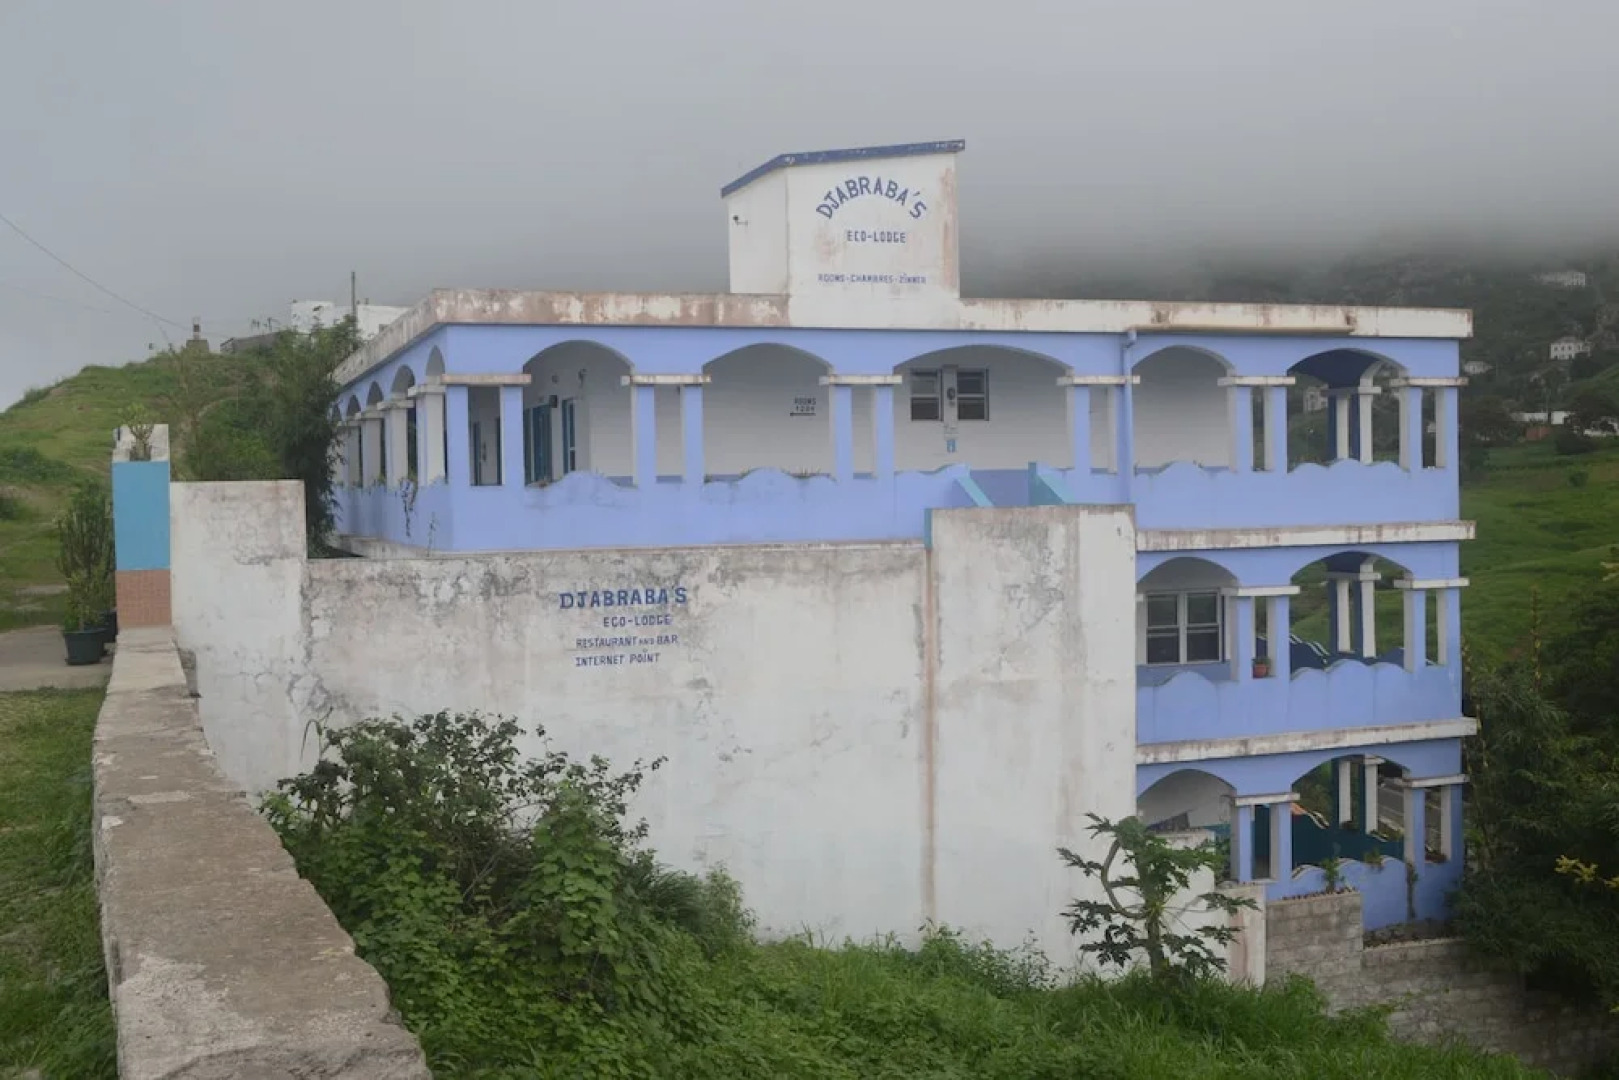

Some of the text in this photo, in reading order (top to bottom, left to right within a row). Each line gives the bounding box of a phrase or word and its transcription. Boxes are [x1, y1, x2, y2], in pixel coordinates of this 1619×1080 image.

[846, 230, 906, 243] ECO-LODGE
[559, 587, 688, 609] DJABRABA'S
[603, 614, 672, 627] ECO-LODGE
[576, 635, 637, 648] RESTAURANT
[656, 634, 679, 645] BAR
[575, 655, 625, 667] INTERNET
